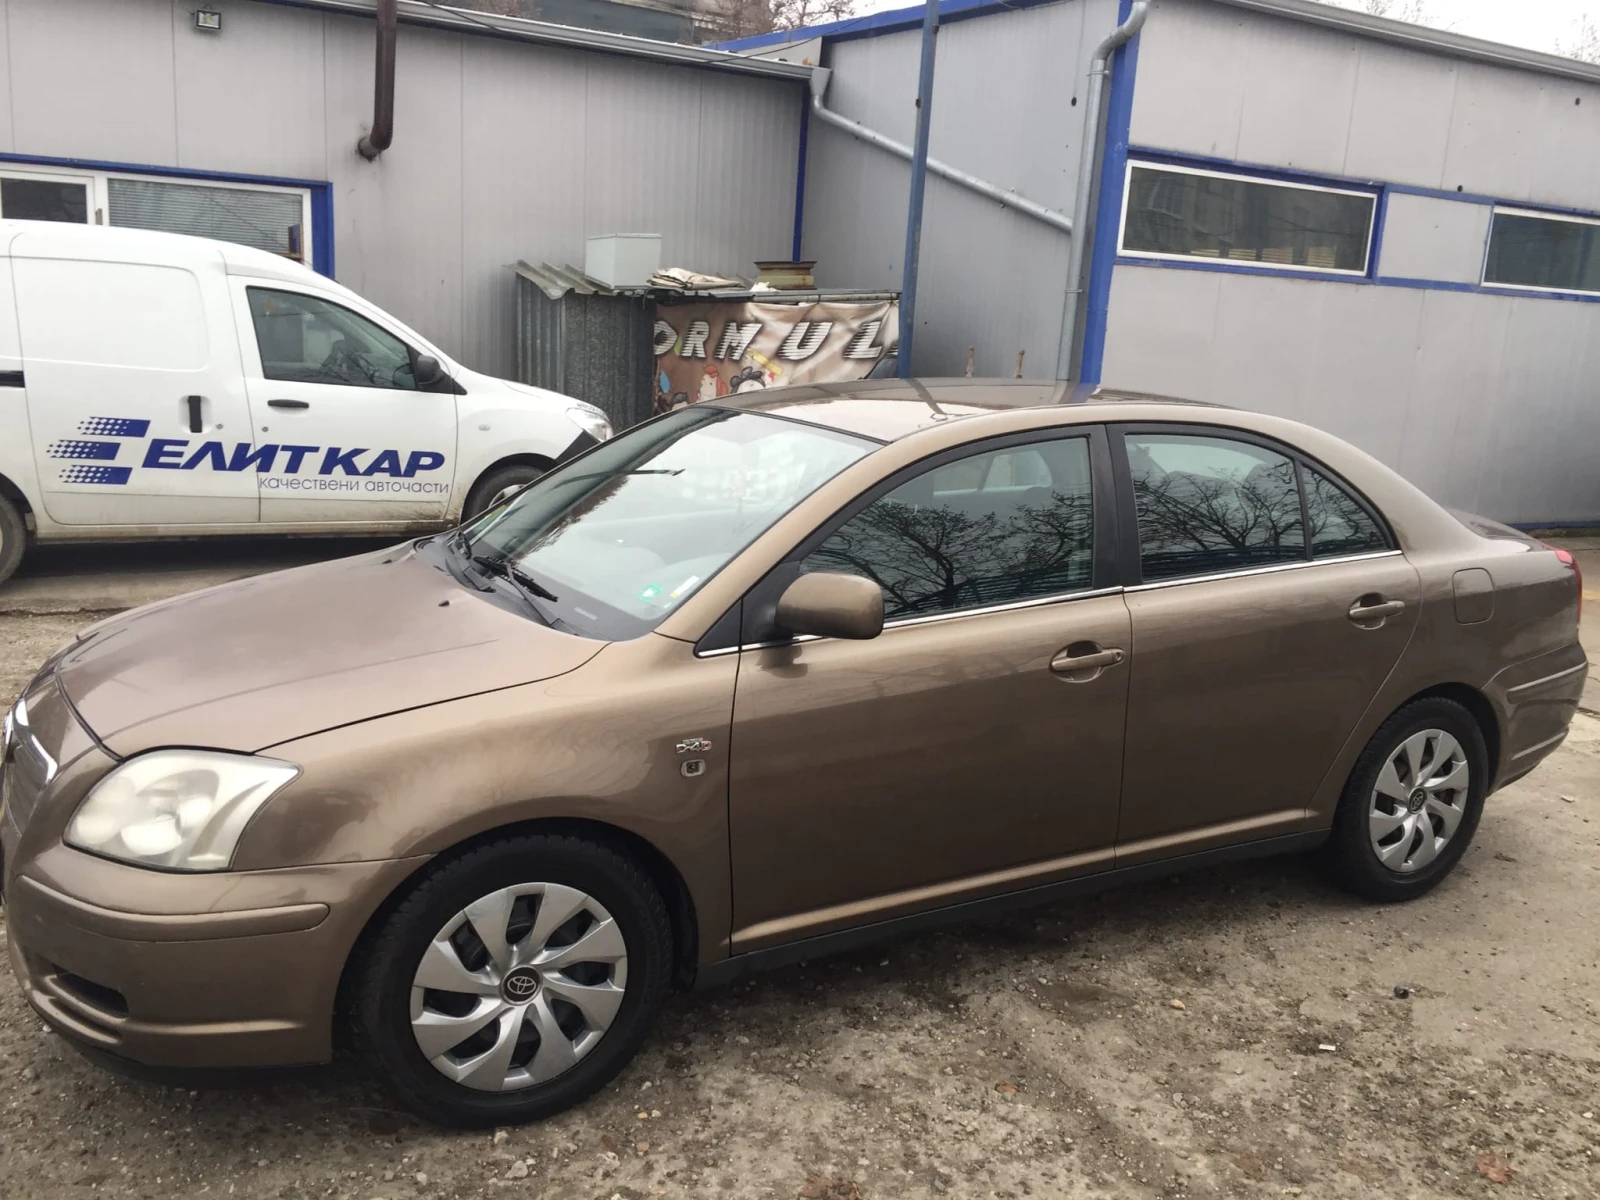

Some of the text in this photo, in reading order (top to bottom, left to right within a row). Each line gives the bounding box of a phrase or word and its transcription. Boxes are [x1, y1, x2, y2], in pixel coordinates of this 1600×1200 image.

[654, 320, 898, 361] ORMUL
[259, 477, 449, 494] качествени авточасти
